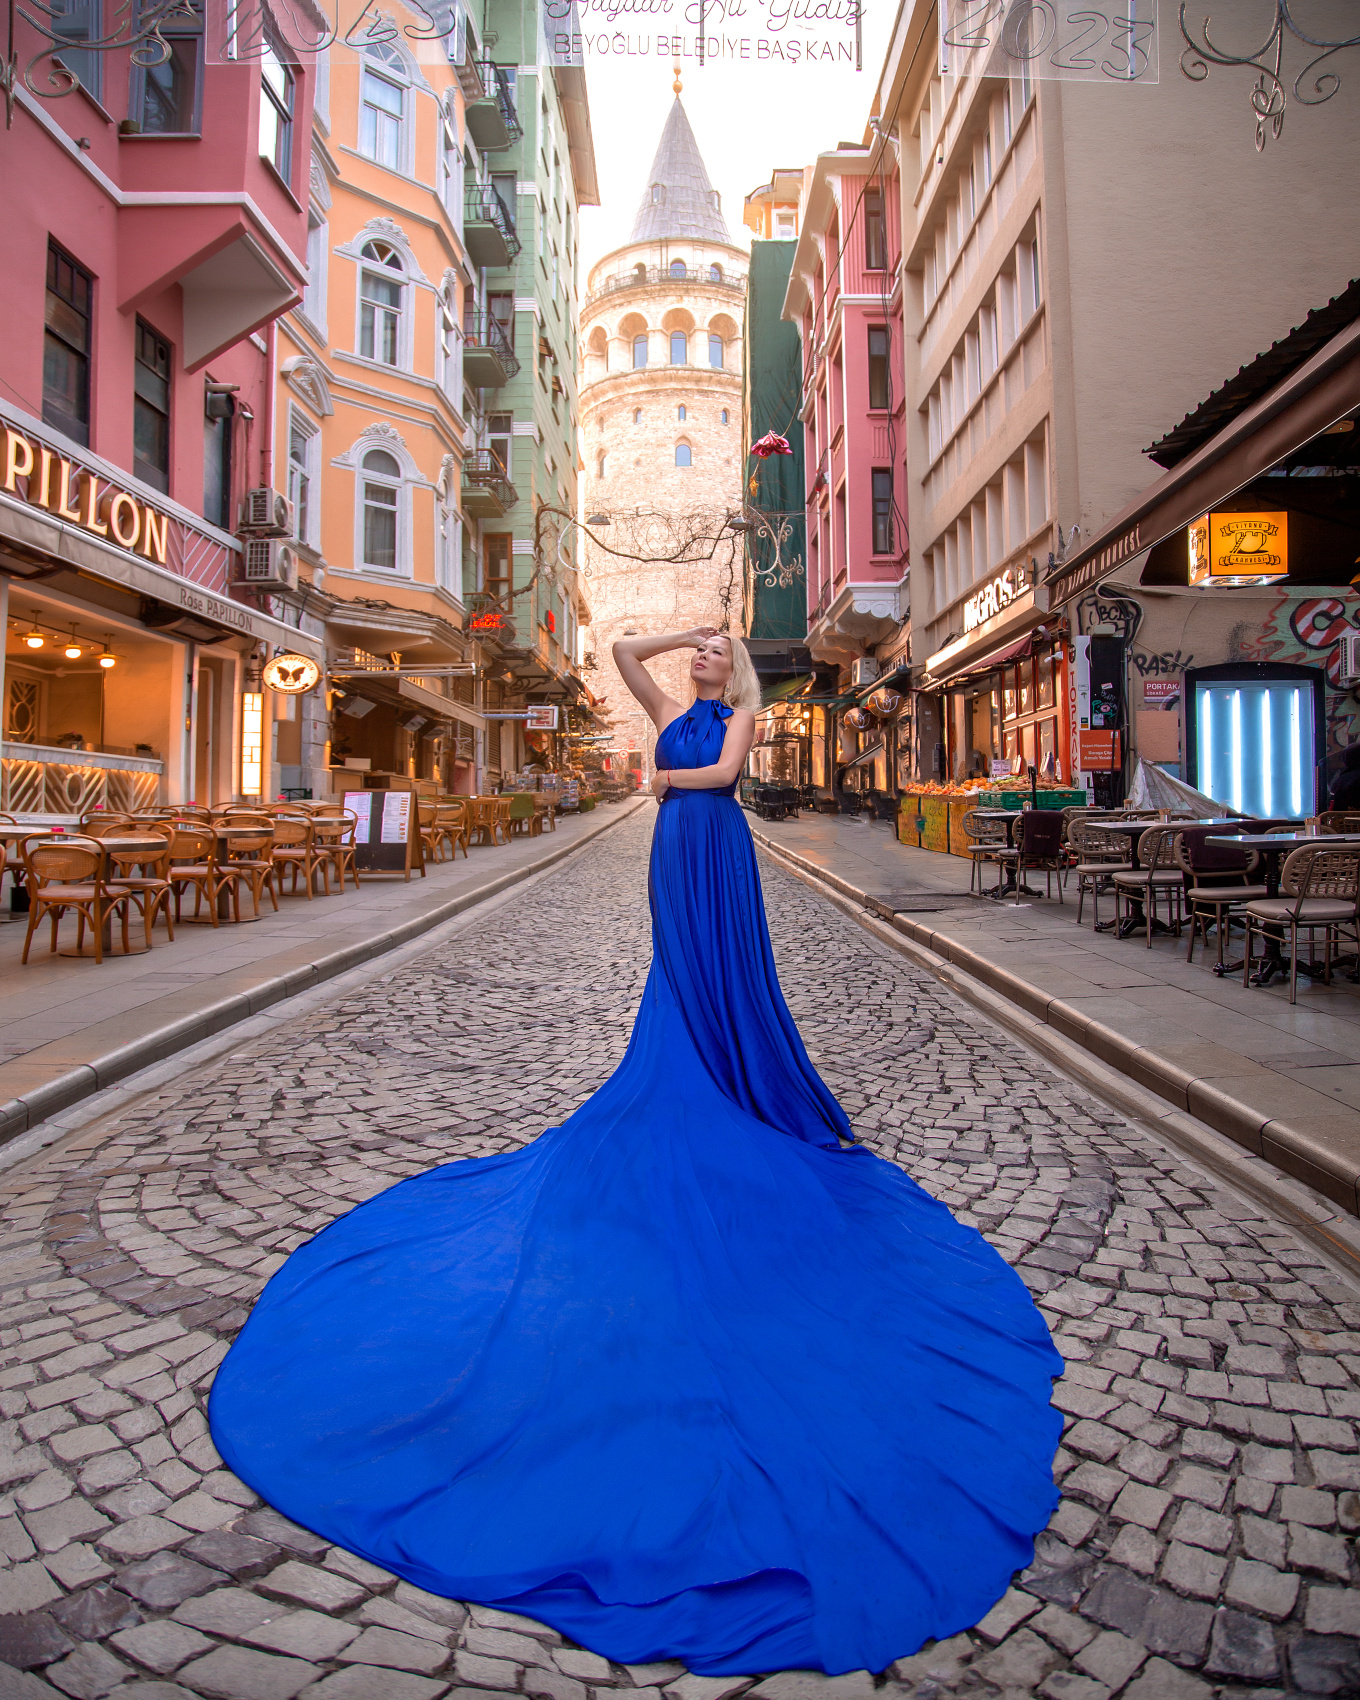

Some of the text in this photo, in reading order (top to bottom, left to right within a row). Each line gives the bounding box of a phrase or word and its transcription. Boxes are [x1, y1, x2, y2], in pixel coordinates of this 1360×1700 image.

[554, 31, 650, 55] BEYOĞLU
[656, 33, 751, 58] BELEDİYE
[180, 588, 253, 631] Rose PAPILLON
